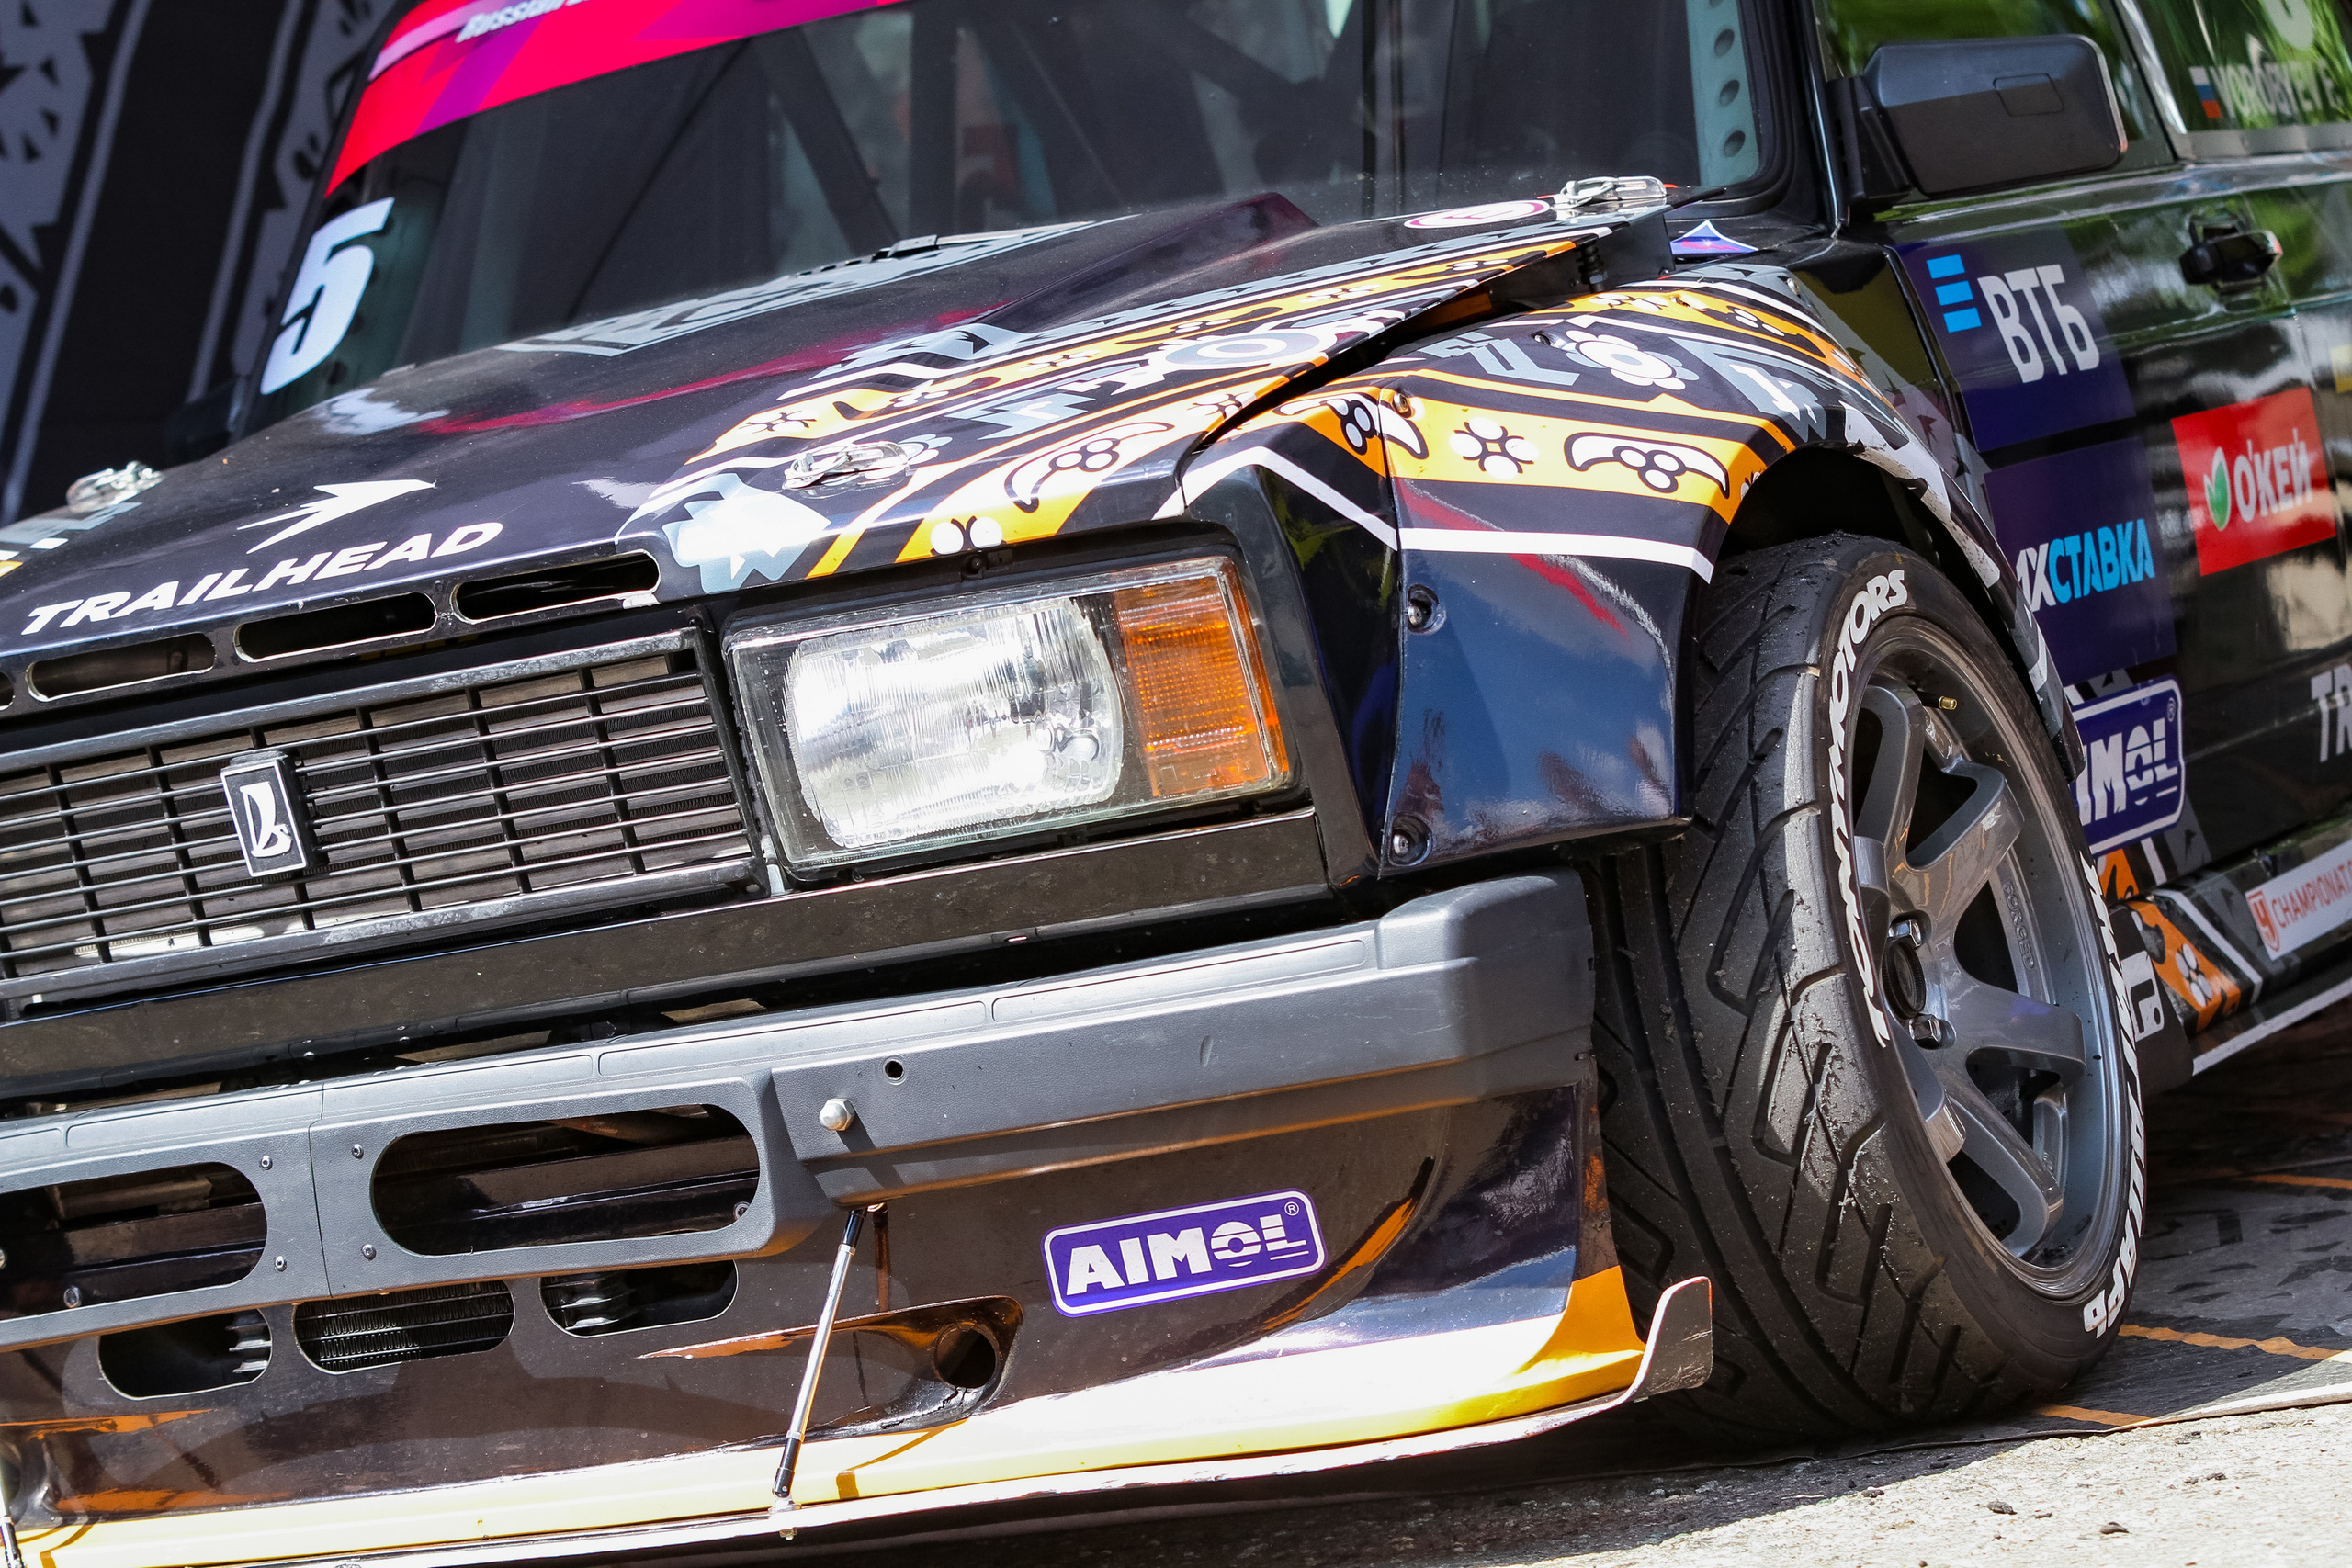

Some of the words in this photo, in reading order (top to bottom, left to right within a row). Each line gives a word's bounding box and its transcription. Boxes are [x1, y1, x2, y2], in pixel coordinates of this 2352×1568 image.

[261, 197, 394, 395] 5
[1977, 264, 2100, 383] ВТБ
[21, 522, 503, 635] TRAILHEAD
